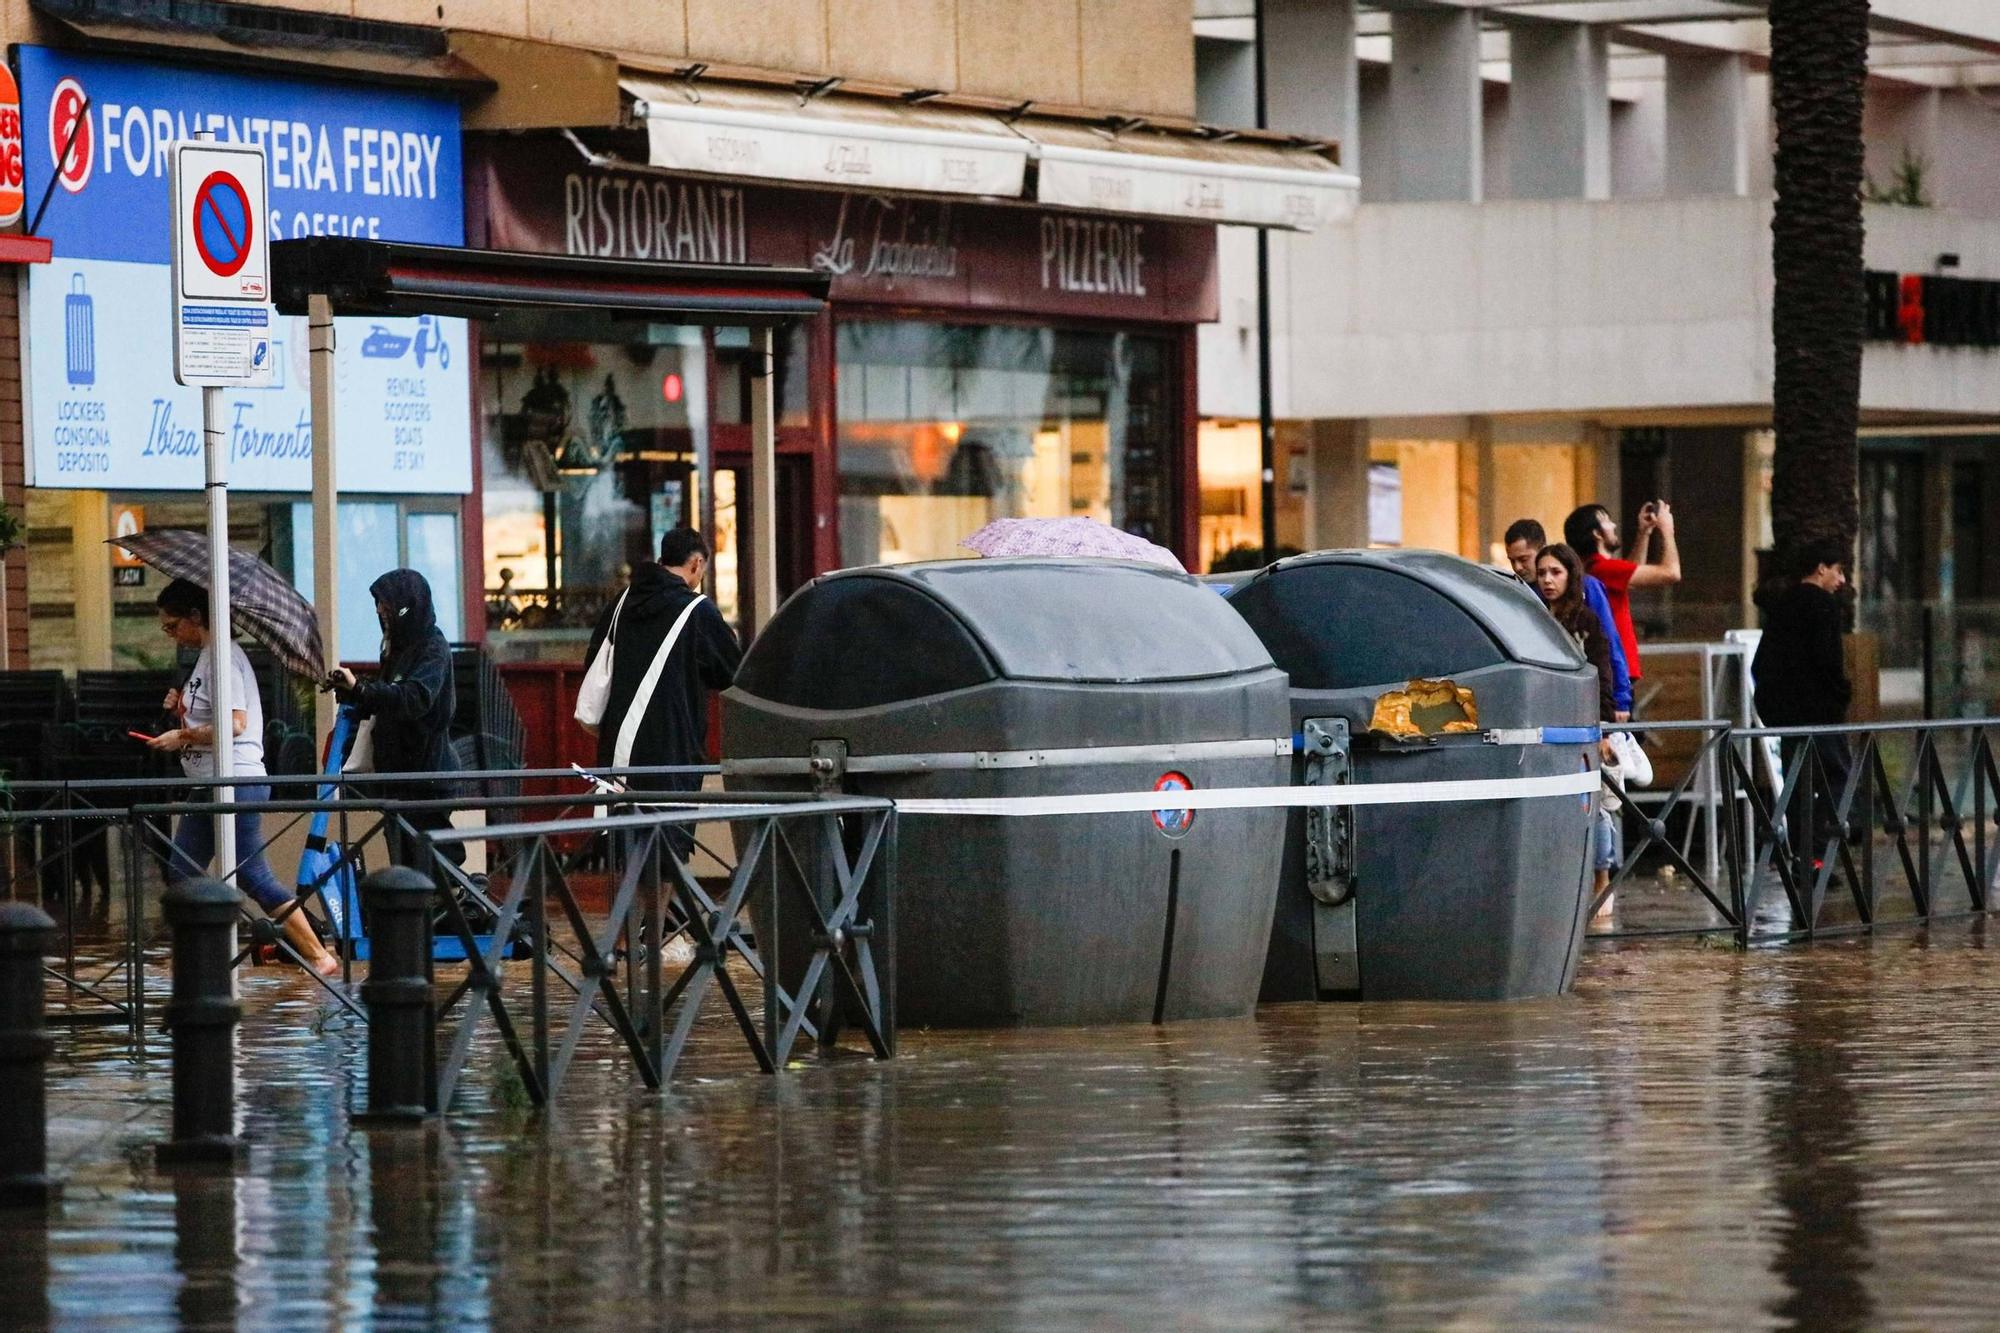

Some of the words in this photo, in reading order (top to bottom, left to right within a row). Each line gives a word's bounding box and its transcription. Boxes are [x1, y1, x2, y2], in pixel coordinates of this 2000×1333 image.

[343, 126, 442, 200] FERRY
[565, 173, 746, 264] RISTORANTI
[1041, 217, 1147, 296] PIZZERIE
[58, 401, 106, 421] LOCKERS
[142, 398, 201, 456] Ibiza
[231, 401, 312, 465] Formente
[384, 402, 431, 421] SCOOTERS
[55, 427, 110, 446] CONSIGNA
[394, 426, 423, 446] BOATS
